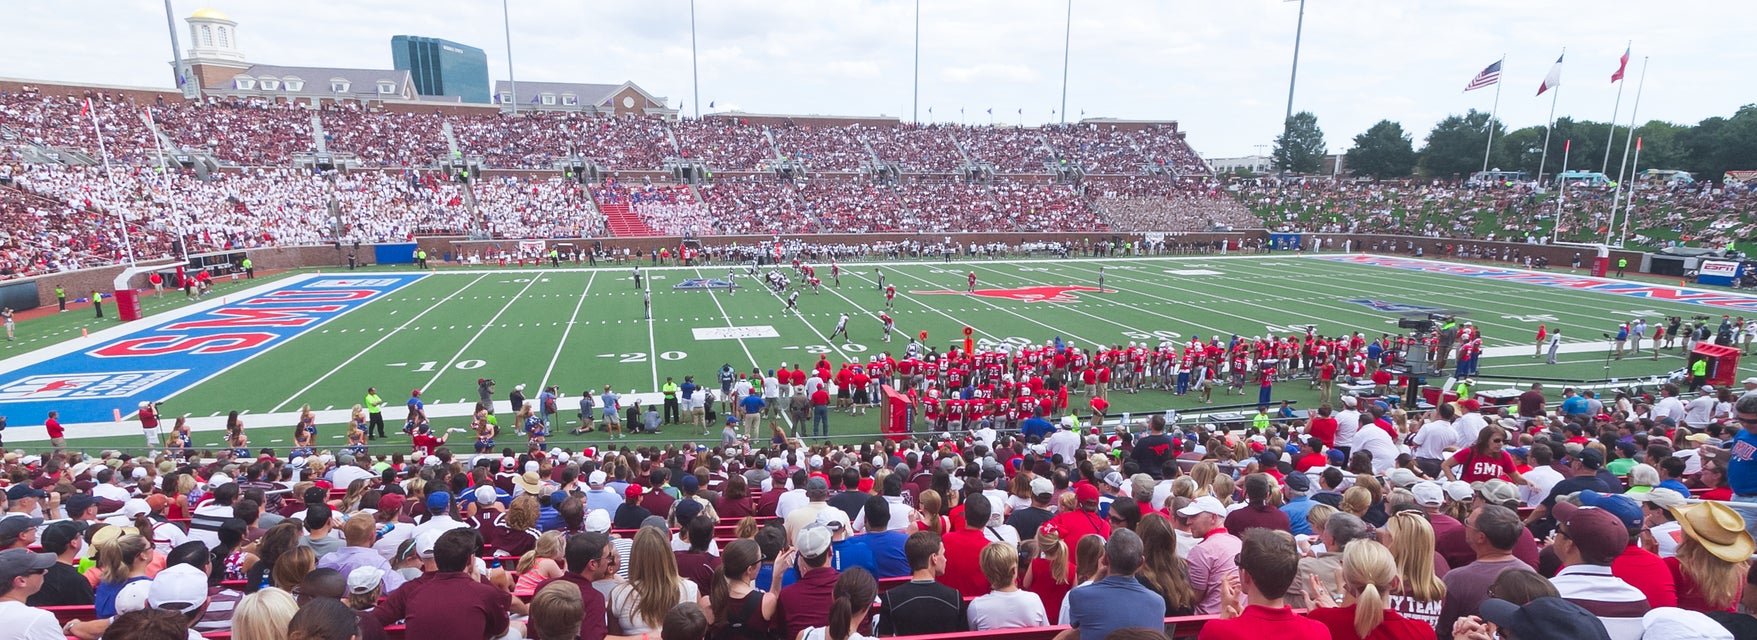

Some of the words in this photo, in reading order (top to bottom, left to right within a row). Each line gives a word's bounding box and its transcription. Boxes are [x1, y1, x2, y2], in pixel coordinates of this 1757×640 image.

[1703, 263, 1735, 271] ESPN
[85, 290, 381, 358] SMU
[1121, 330, 1181, 339] 50
[805, 344, 868, 354] 30
[619, 351, 687, 363] 20
[411, 359, 487, 372] 10
[951, 405, 962, 413] 76
[1406, 596, 1442, 615] TEAM
